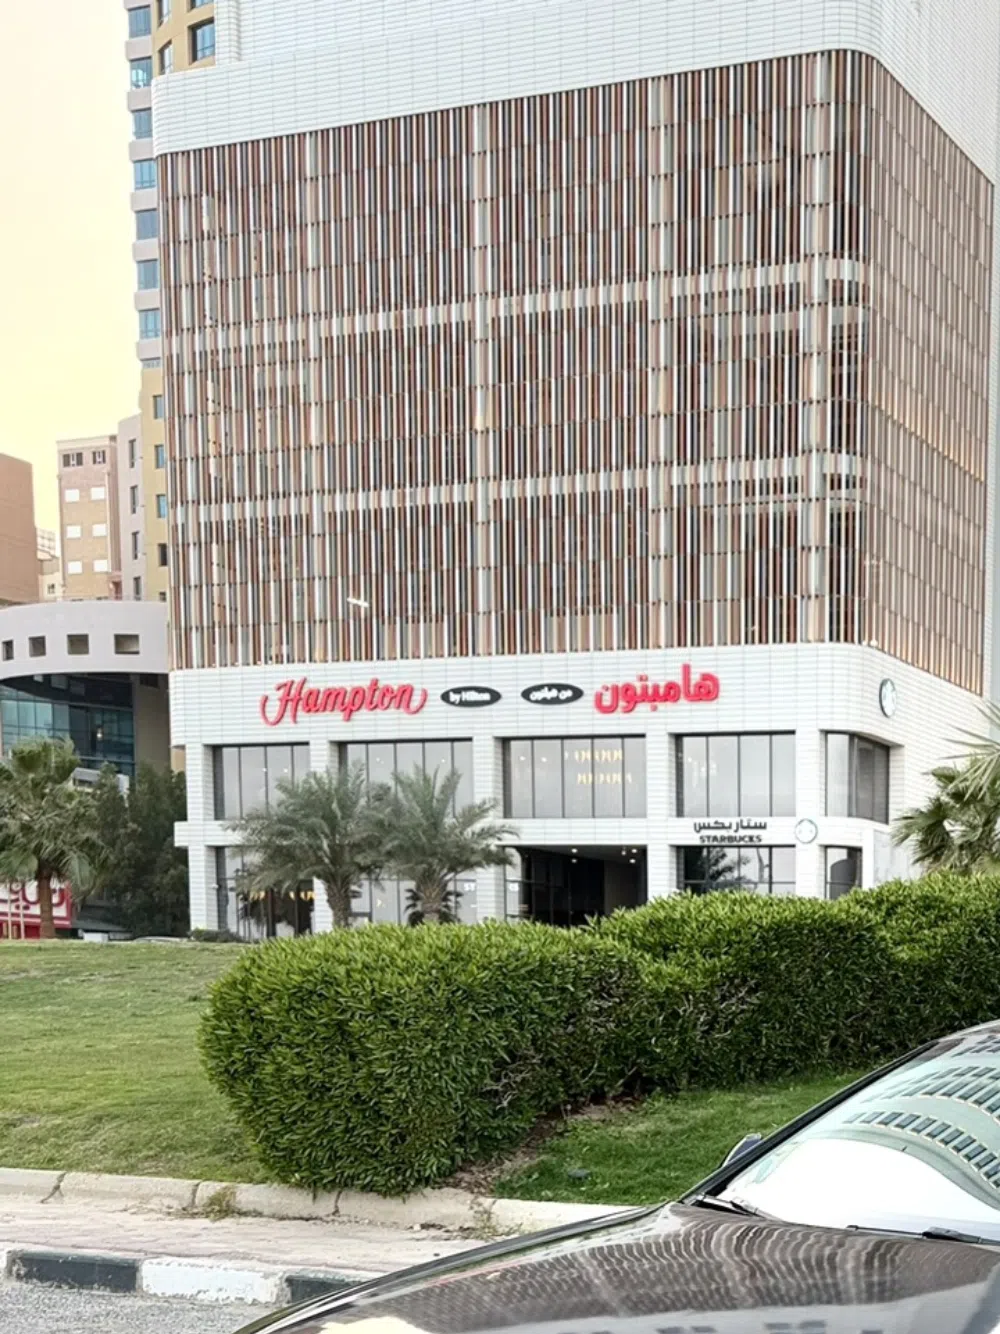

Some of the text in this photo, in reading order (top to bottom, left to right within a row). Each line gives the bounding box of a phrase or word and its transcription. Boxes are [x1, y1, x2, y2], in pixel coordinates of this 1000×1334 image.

[260, 676, 428, 726] Hampton
[594, 662, 720, 714] هامبتون
[699, 834, 763, 844] STARBUCKS
